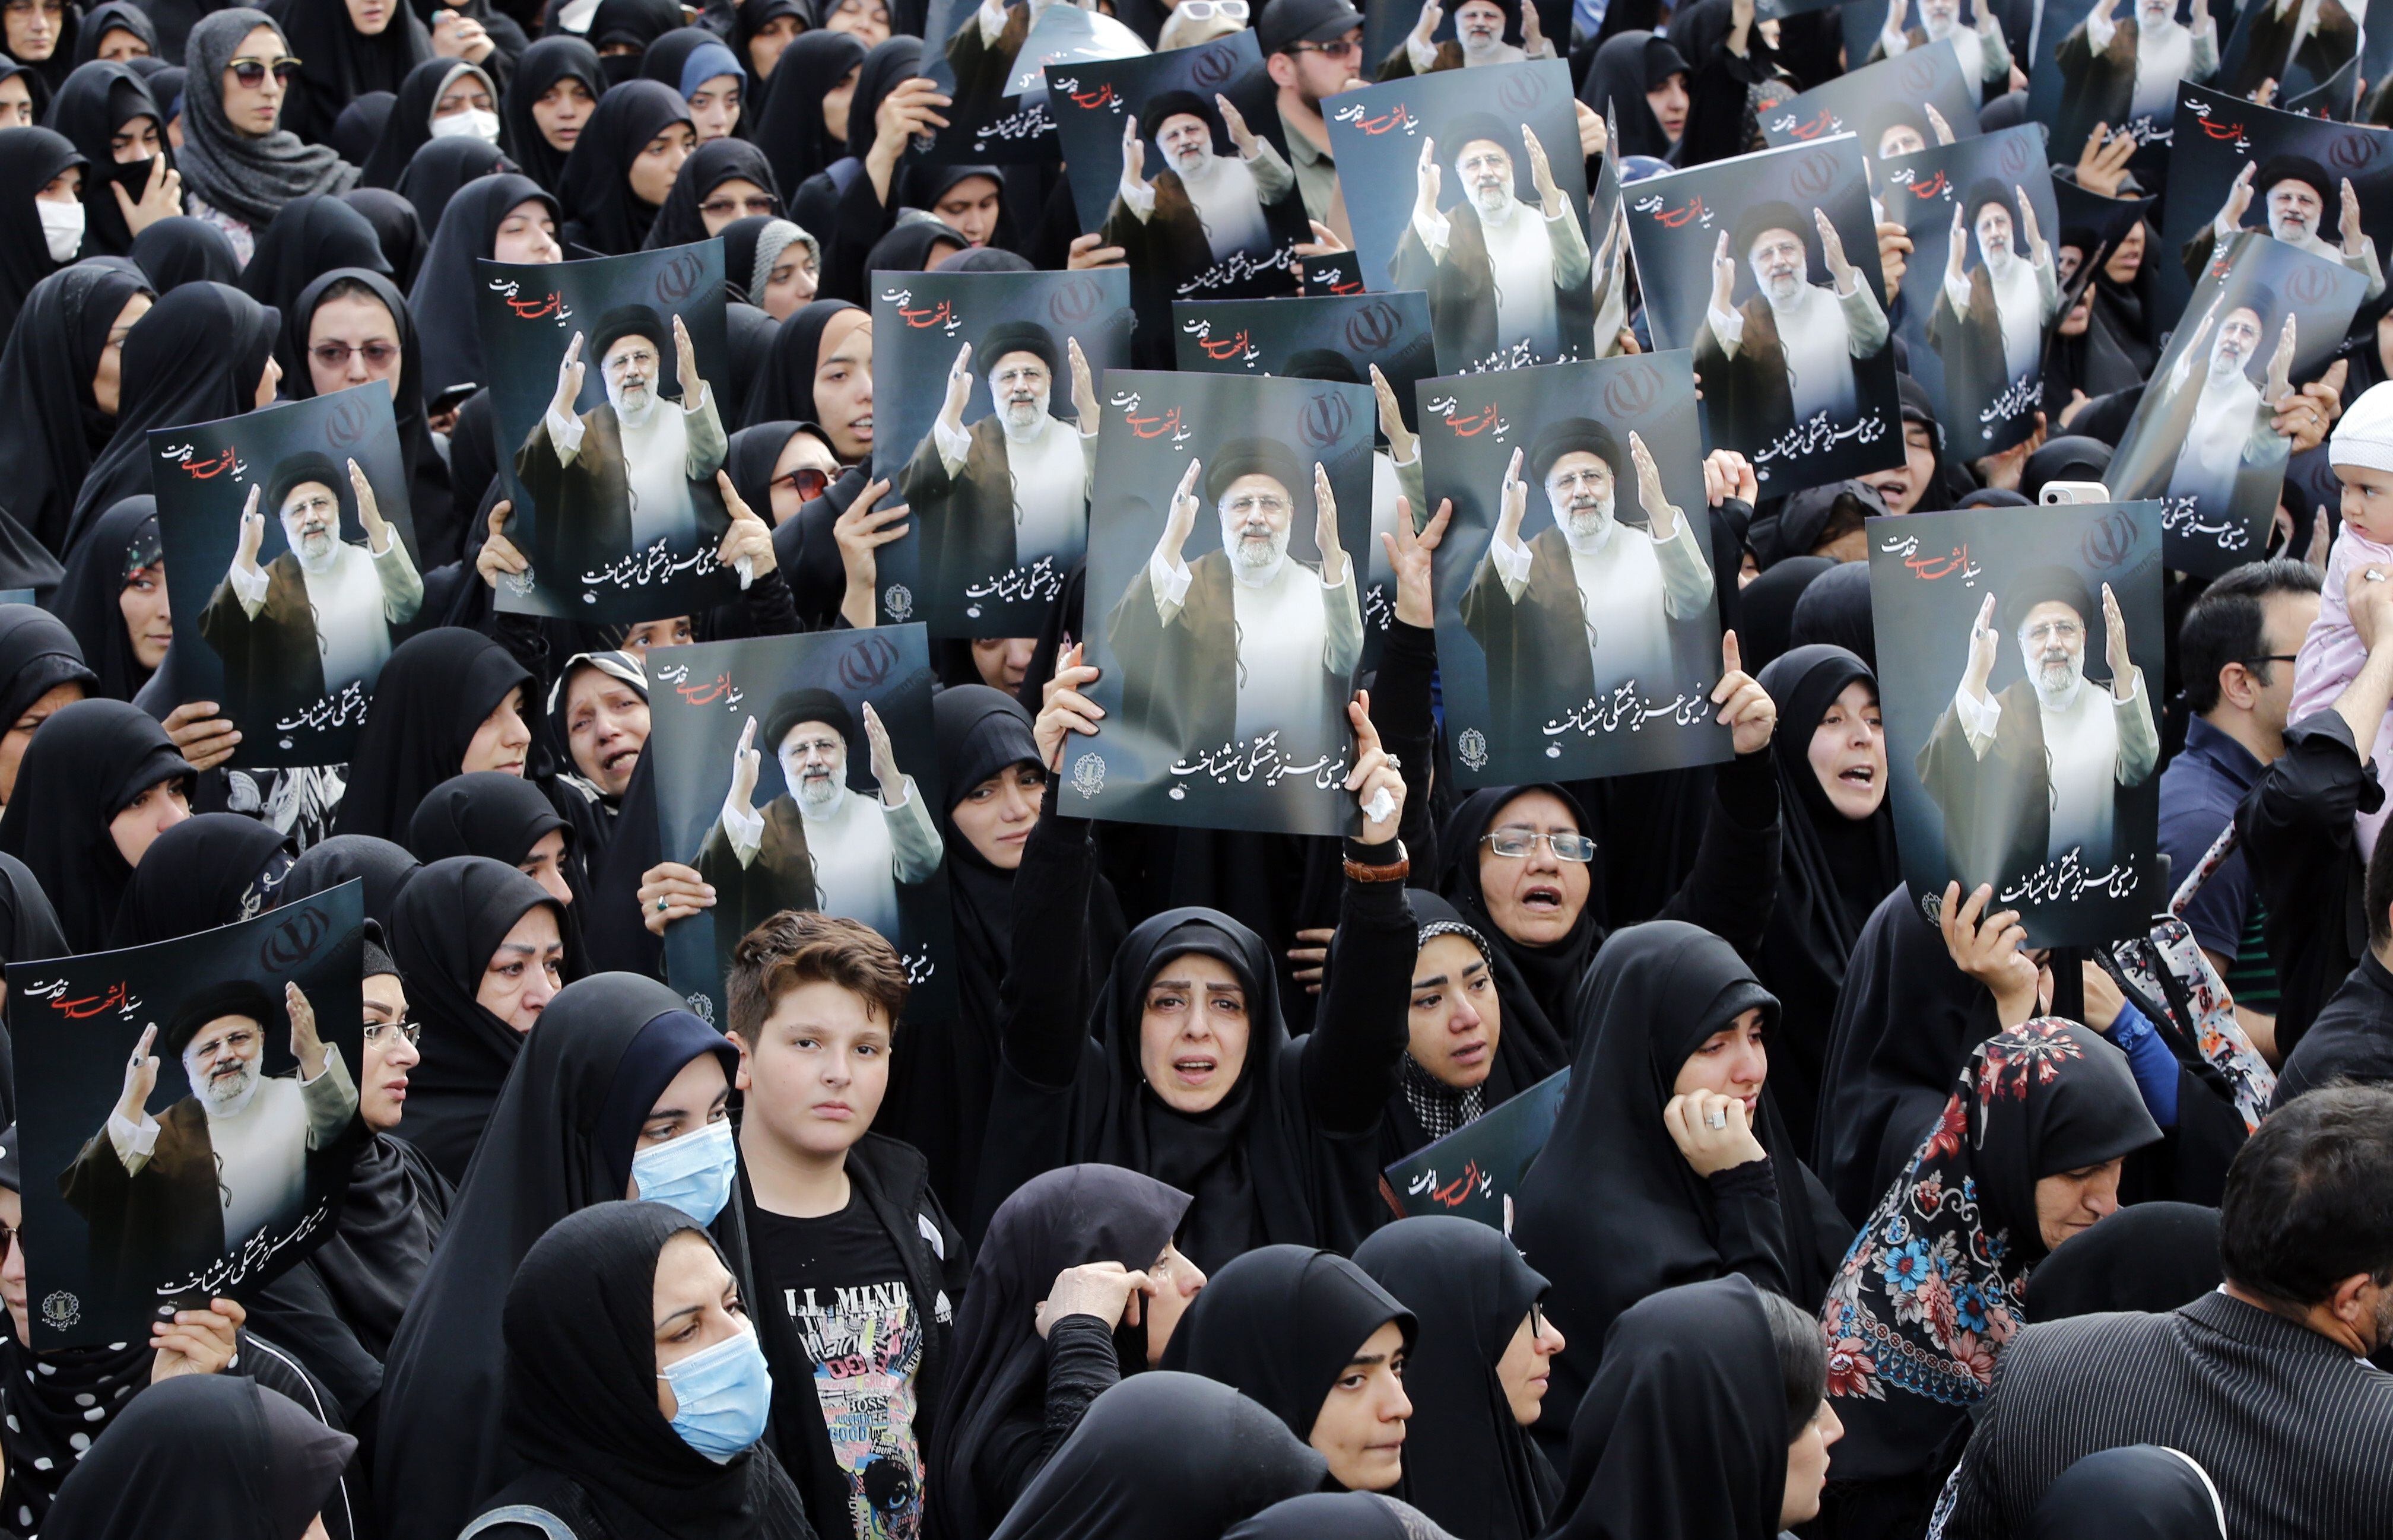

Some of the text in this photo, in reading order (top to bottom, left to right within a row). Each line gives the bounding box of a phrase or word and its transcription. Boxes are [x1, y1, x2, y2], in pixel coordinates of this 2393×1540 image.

[1334, 103, 1366, 122] خدمت
[1634, 195, 1664, 214] خدمت
[1221, 249, 1245, 284] خستگی
[1243, 248, 1283, 281] عزیز
[1312, 268, 1341, 285] خدمت
[488, 278, 520, 297] خدمت
[881, 288, 913, 307] خدمت
[1182, 319, 1211, 338] خدمت
[1110, 390, 1141, 414] خدمت
[1426, 395, 1458, 417] خدمت
[1801, 409, 1829, 455] خستگی
[1822, 417, 1868, 452] عزیز
[1858, 406, 1886, 444] رئیسی
[161, 443, 195, 463] خدمت
[2182, 513, 2233, 538] عزیز
[2217, 517, 2250, 551] رئیسی
[636, 536, 667, 585] خستگی
[1880, 534, 1919, 558] خدمت
[660, 547, 706, 585] عزیز
[1020, 554, 1054, 601] خستگی
[657, 663, 690, 685] خدمت
[331, 679, 362, 727] خستگی
[1602, 678, 1636, 732] خستگی
[1629, 693, 1686, 732] عزیز
[1675, 681, 1709, 726] رئیسی
[1236, 729, 1280, 789] خستگی
[1265, 752, 1331, 787] عزیز
[2048, 850, 2081, 901] خستگی
[2070, 863, 2121, 902] عزیز
[2108, 852, 2138, 899] رئیسی
[24, 978, 69, 1000] خدمت
[296, 1195, 329, 1241] رئیسی
[230, 1224, 268, 1285] خستگی
[256, 1215, 310, 1272] عزیز
[847, 1396, 887, 1413] BOSS
[829, 1425, 868, 1442] GOOD
